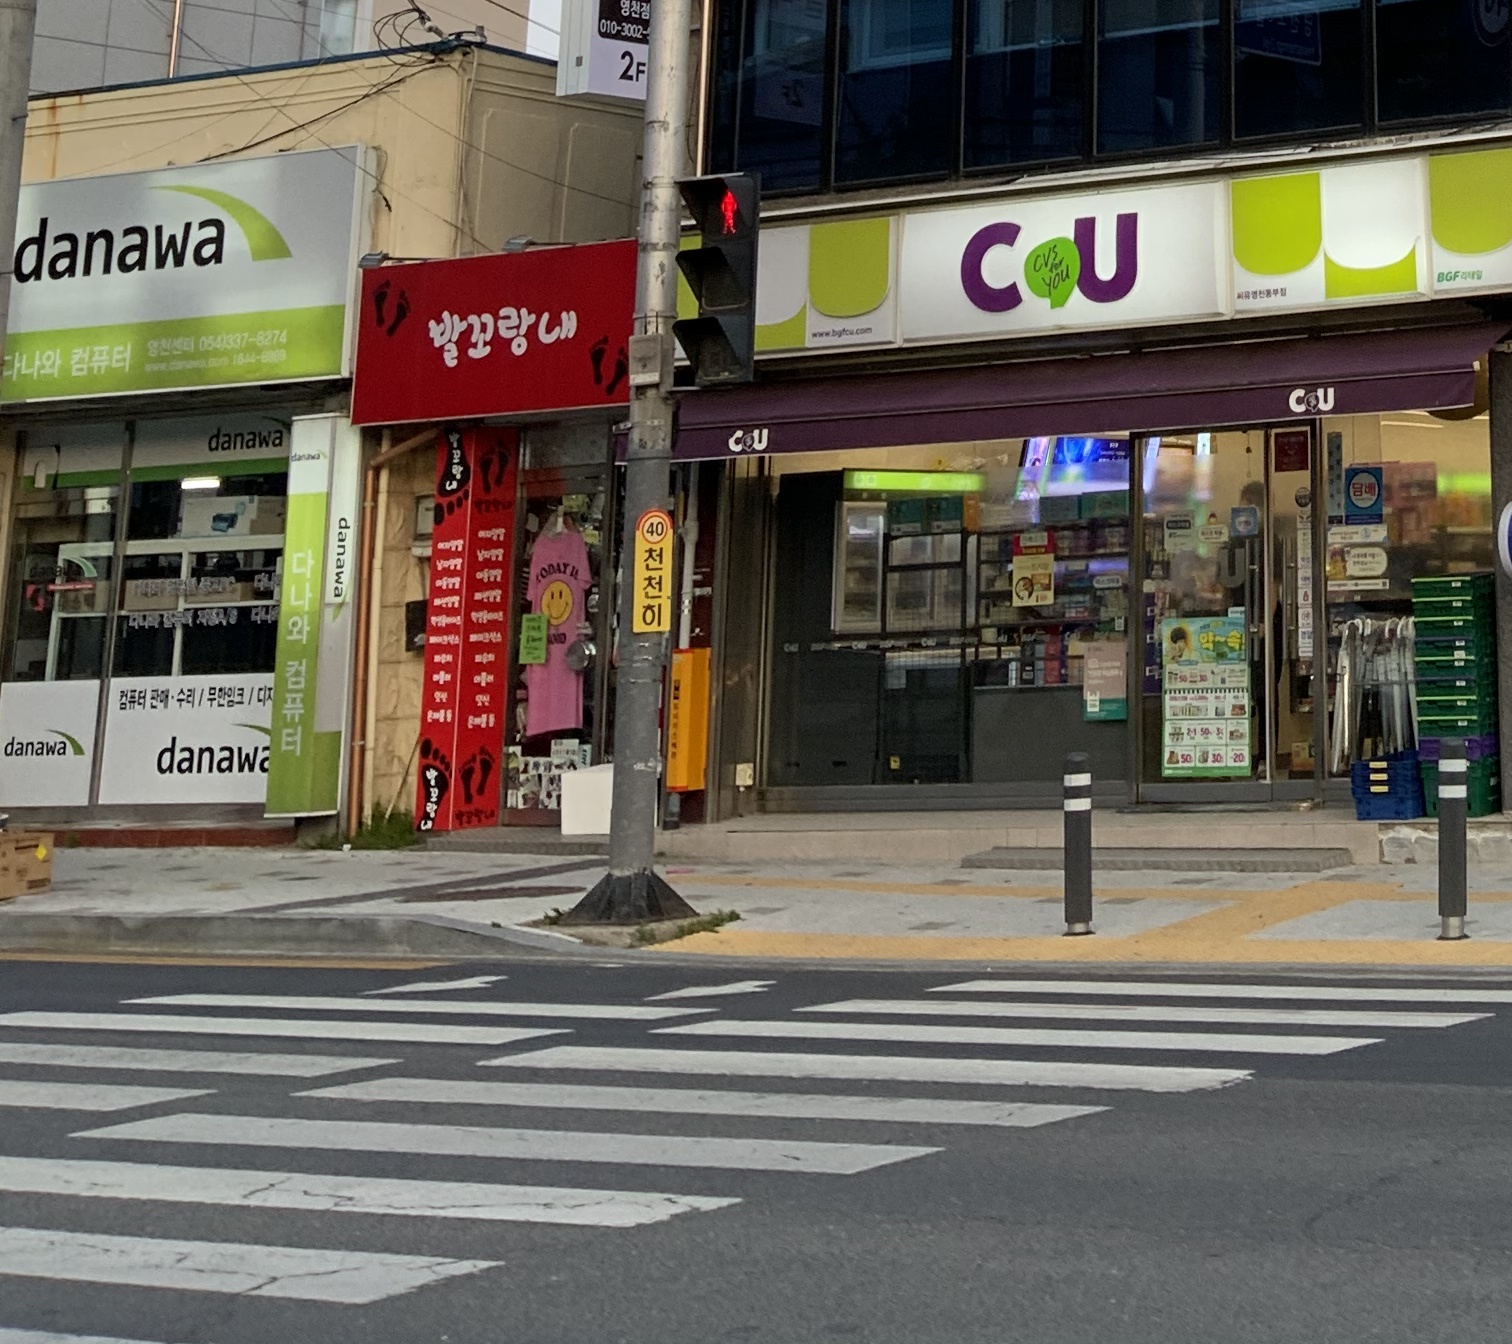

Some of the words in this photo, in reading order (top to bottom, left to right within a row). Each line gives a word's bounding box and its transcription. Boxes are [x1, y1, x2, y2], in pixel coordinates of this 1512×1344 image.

[618, 50, 646, 82] 2F
[13, 217, 226, 283] danawa
[960, 212, 1139, 313] CU
[428, 306, 578, 368] 발꼬랑내
[811, 326, 873, 339] www.bgfcu.com
[71, 342, 132, 376] 컴퓨터
[1289, 387, 1335, 412] CU
[208, 426, 283, 452] danawa
[728, 428, 769, 453] CU
[290, 452, 322, 462] danawa
[646, 522, 664, 538] 40
[333, 517, 350, 599] danawa
[536, 562, 570, 582] TODAY
[642, 547, 665, 628] 천천히
[118, 688, 147, 710] 컴퓨터
[207, 685, 246, 708] 무한잉크
[281, 658, 306, 756] 컴퓨터
[4, 736, 67, 758] danawa
